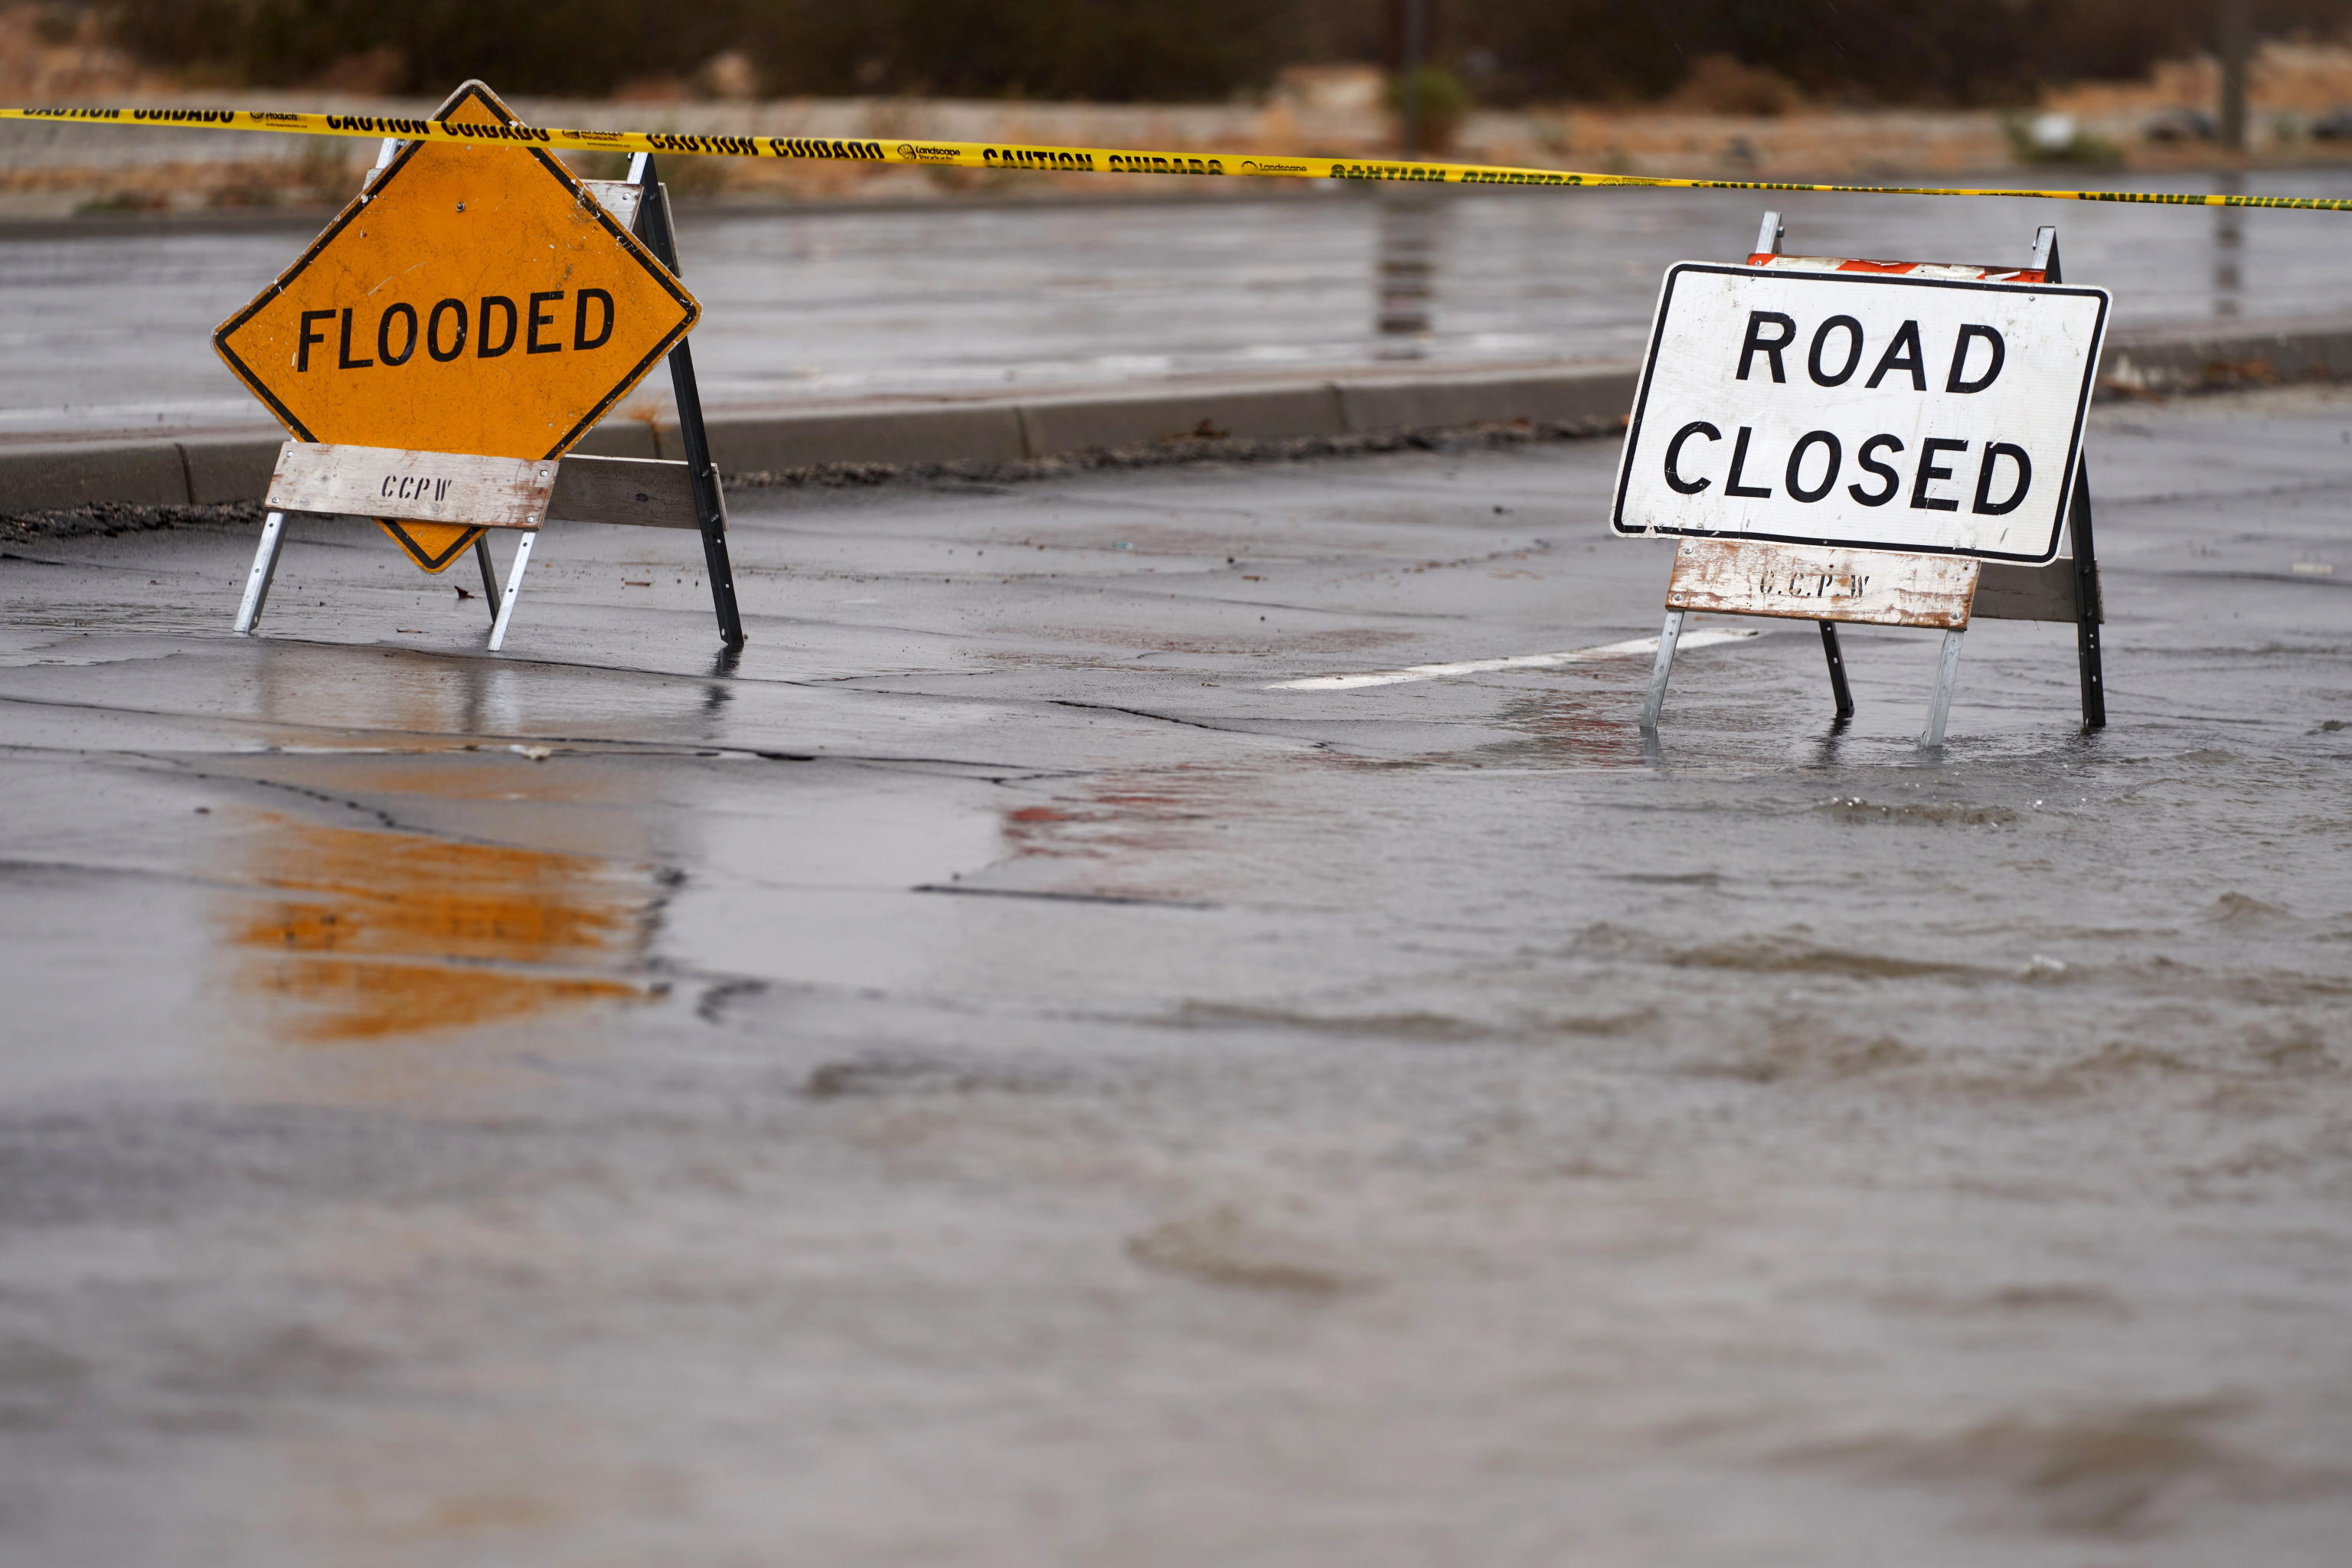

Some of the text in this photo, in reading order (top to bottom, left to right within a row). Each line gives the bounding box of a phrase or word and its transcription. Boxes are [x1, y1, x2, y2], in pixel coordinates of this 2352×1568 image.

[326, 115, 550, 142] CAUTION CUIDADO
[645, 134, 885, 159] CAUTION CUIDADO
[916, 145, 961, 156] Landscape
[296, 288, 615, 373] FLOODED
[1735, 311, 2006, 394] ROAD
[1664, 421, 2032, 516] CLOSED
